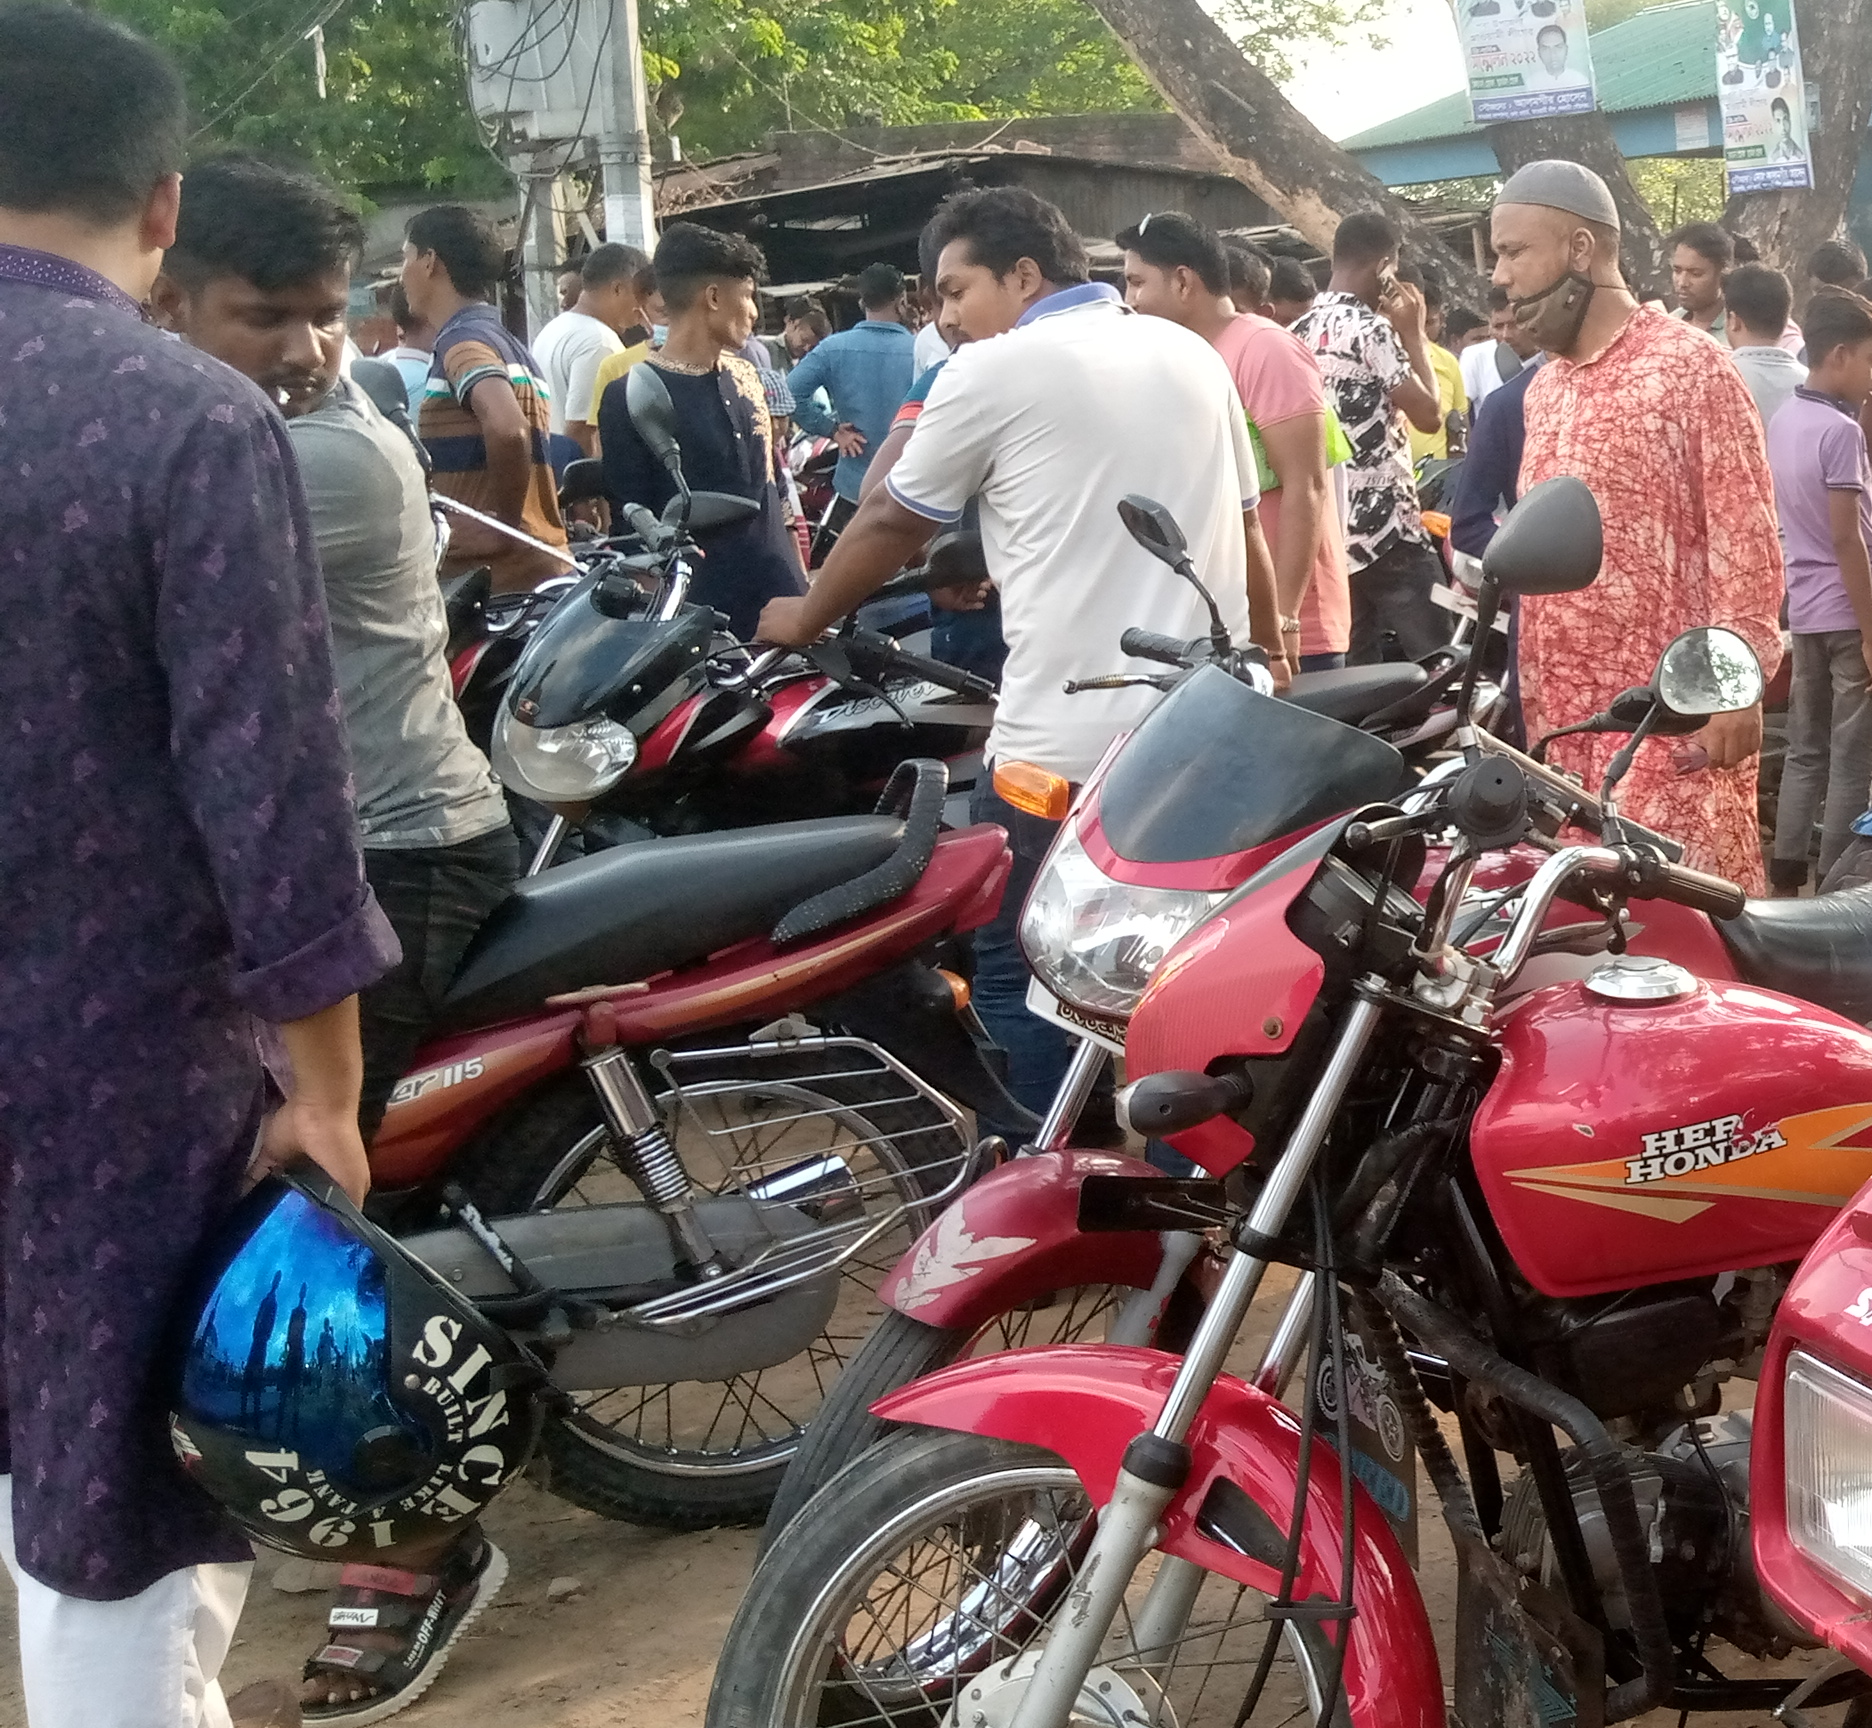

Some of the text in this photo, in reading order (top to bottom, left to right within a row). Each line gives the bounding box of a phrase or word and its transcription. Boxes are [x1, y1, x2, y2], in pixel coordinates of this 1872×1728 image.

[443, 1056, 485, 1089] 115
[244, 1314, 510, 1549] SINCE 1964
[421, 1375, 466, 1444] BUILT
